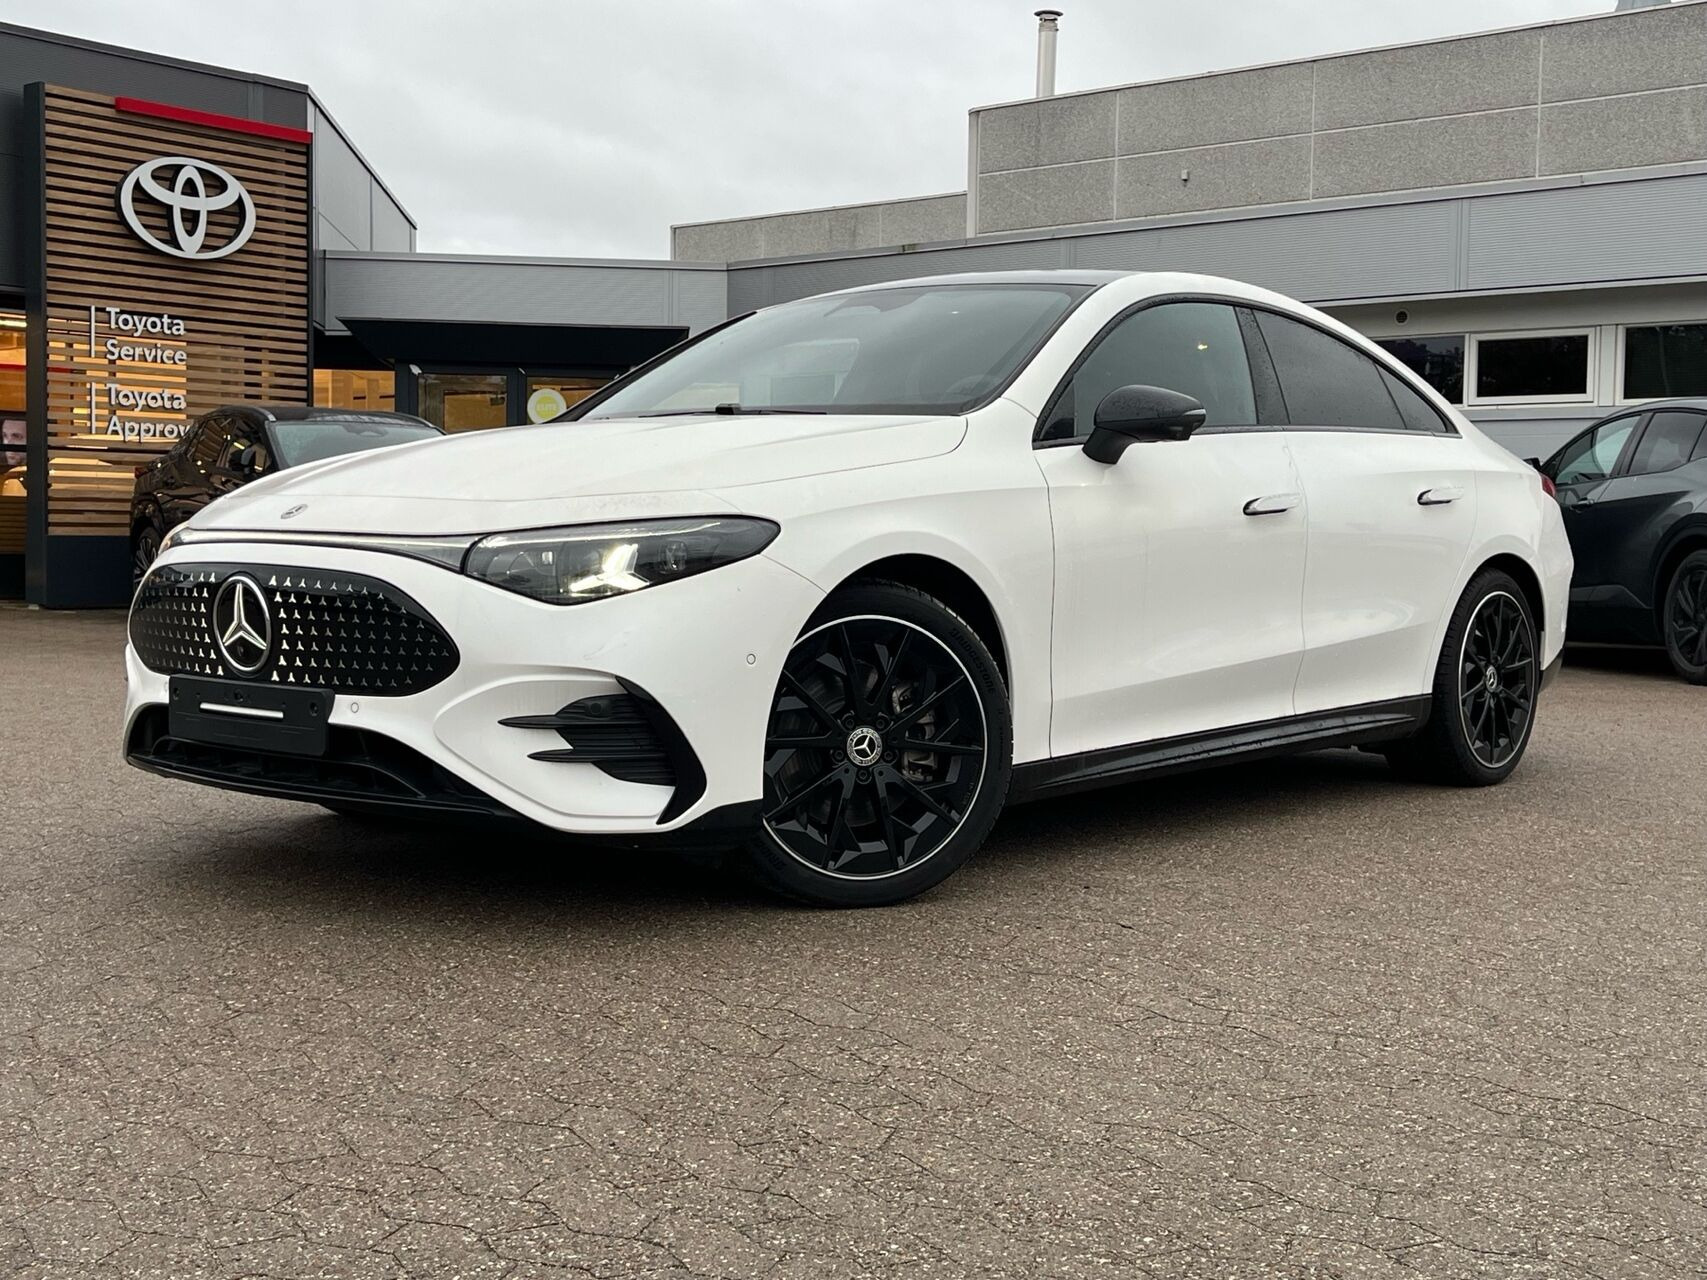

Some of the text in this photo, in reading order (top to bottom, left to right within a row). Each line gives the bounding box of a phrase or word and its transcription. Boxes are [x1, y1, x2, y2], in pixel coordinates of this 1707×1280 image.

[106, 307, 185, 336] Toyota
[106, 339, 187, 365] Service
[106, 383, 187, 411] Toyota
